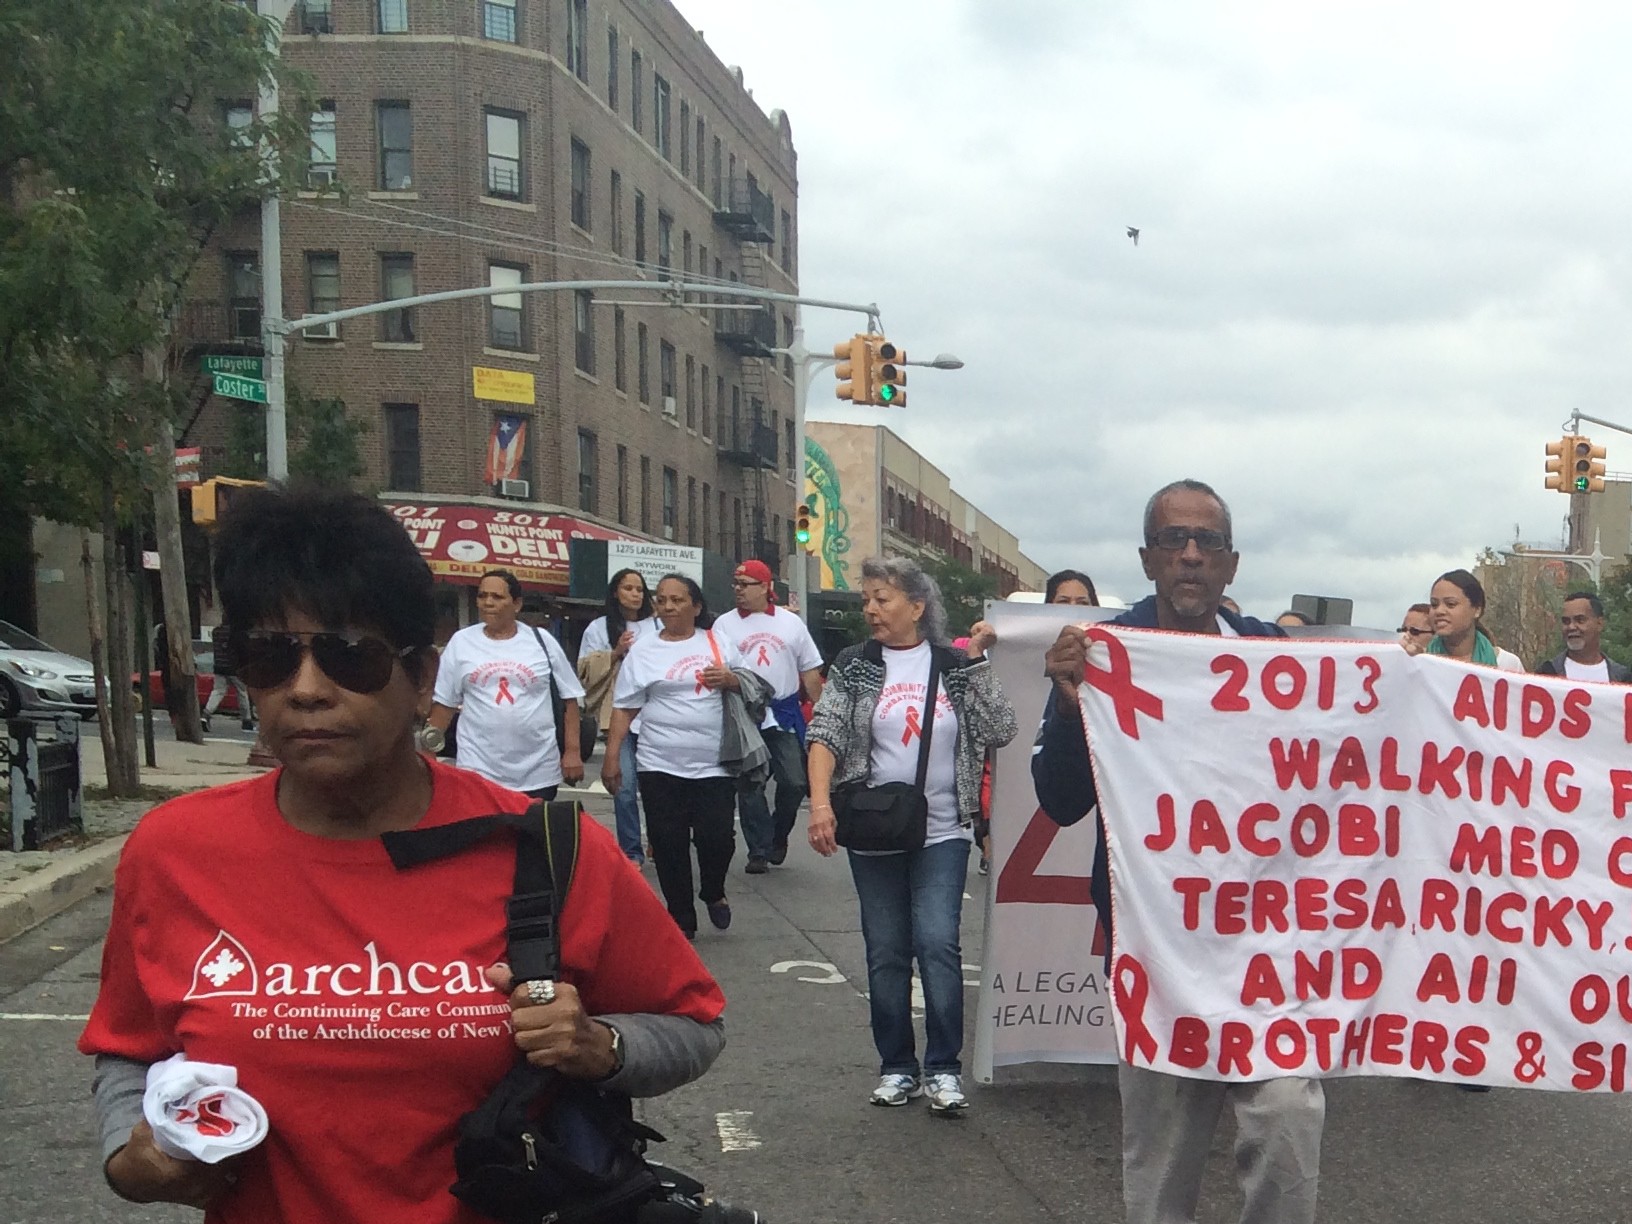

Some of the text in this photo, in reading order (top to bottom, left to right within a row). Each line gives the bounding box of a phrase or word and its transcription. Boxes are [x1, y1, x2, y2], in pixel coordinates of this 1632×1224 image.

[207, 357, 258, 372] Lafayette
[215, 375, 255, 398] Coster
[384, 505, 439, 518] 01
[493, 511, 549, 527] 801
[403, 518, 446, 530] POINT
[486, 523, 528, 538] HUNTS
[530, 527, 563, 541] POINT
[489, 535, 570, 561] DELI
[615, 544, 635, 555] 1275
[636, 545, 678, 559] LAFAYETTE
[879, 694, 926, 720] COMBATING
[1210, 653, 1382, 715] 2013
[1453, 673, 1593, 740] AIDS
[1268, 736, 1582, 814] WALKING
[1144, 793, 1401, 858] JACOBI
[1449, 822, 1580, 880] MED
[265, 941, 495, 996] archcar
[1240, 947, 1383, 1007] AND
[1016, 971, 1107, 994] LEGA
[231, 1001, 512, 1022] The Continuing Care Commun
[253, 1023, 275, 1040] of
[278, 1023, 309, 1040] the
[313, 1023, 432, 1040] Archdiocese
[437, 1023, 459, 1039] of
[462, 1022, 501, 1038] New
[1168, 1013, 1491, 1076] BROTHERS
[1513, 1031, 1546, 1083] &
